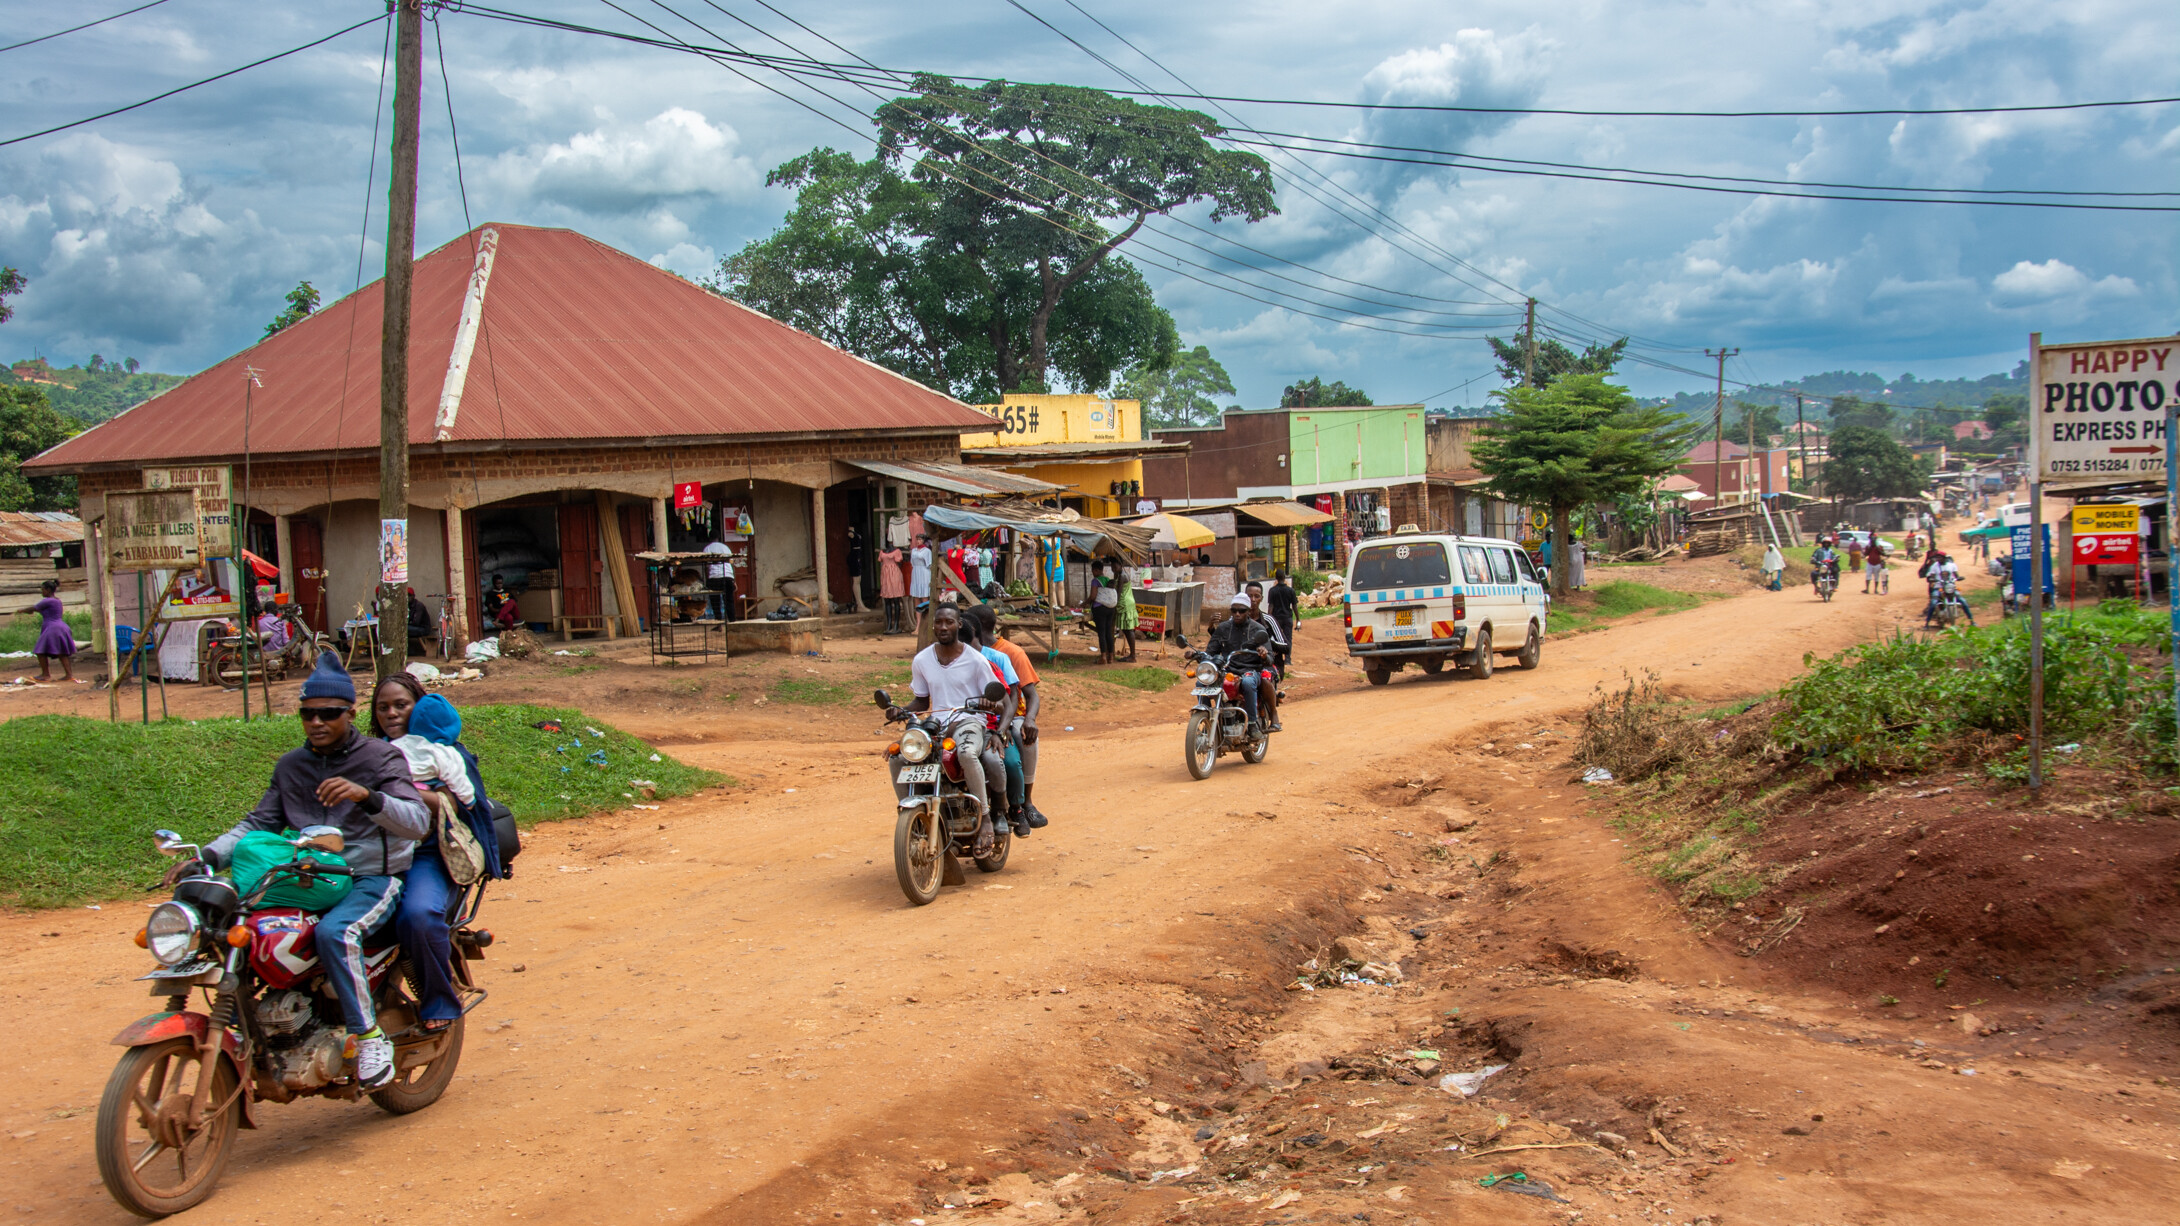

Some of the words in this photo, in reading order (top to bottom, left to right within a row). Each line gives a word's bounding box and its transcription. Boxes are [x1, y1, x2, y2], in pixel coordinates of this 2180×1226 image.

[2071, 348, 2171, 374] HAPPY
[2044, 380, 2165, 413] PHOTO
[2053, 421, 2136, 441] EXPRESS
[2051, 461, 2080, 472] 0752
[2084, 460, 2129, 472] 515284
[169, 469, 199, 483] VISION
[201, 469, 218, 482] FOR
[2096, 510, 2134, 519] MOBILE
[112, 526, 129, 538] ALFA
[132, 524, 156, 537] MAIZE
[160, 522, 195, 536] MILLERS
[2096, 520, 2134, 529] MONEY
[2102, 537, 2132, 546] airtel
[125, 546, 184, 561] KYABAKADDE
